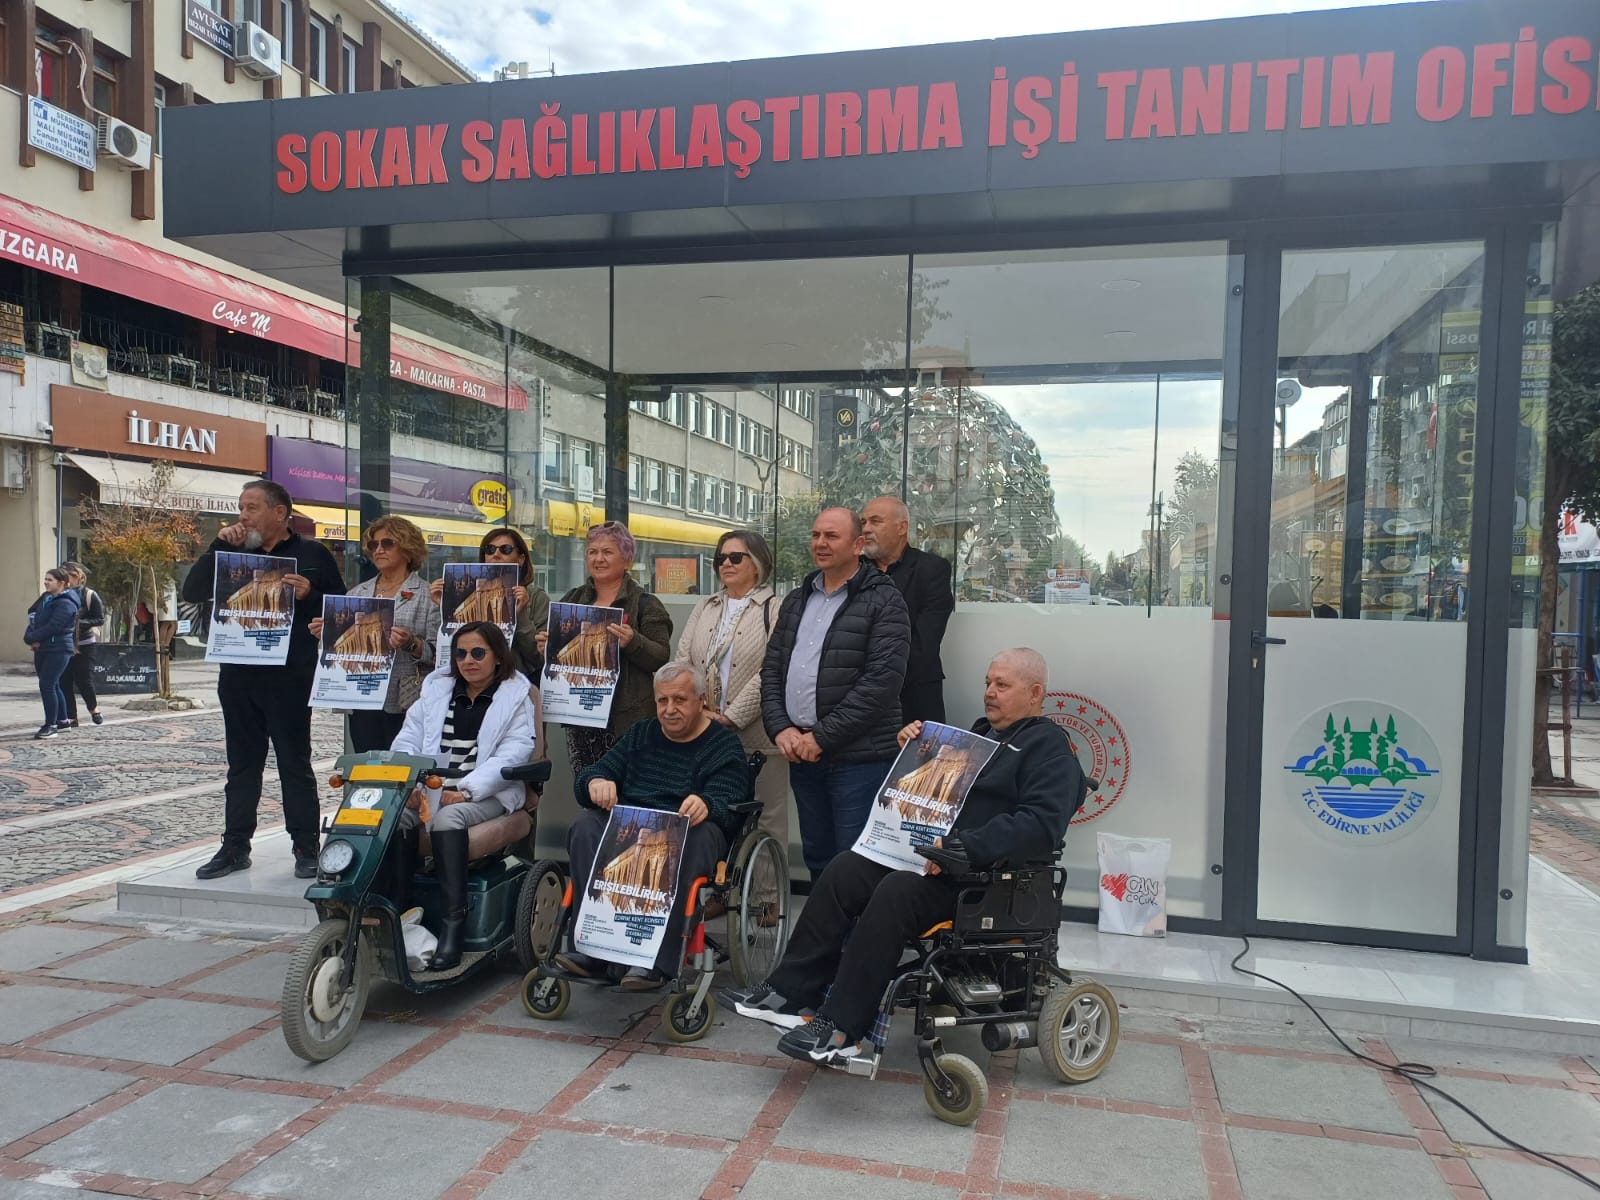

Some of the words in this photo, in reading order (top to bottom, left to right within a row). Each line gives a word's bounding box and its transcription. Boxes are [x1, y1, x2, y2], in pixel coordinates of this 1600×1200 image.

[191, 7, 230, 38] AVUKAT
[56, 111, 84, 129] SERBEST
[276, 123, 449, 194] SOKAK
[461, 82, 963, 182] SAĞLIKLAŞTIRMA
[987, 62, 1077, 159] İŞİ
[1097, 51, 1395, 140] TANITIM
[1415, 26, 1600, 121] OFİS
[0, 229, 79, 274] IZGARA
[212, 301, 248, 327] Cafe
[251, 311, 271, 332] M
[410, 366, 455, 391] MAKARNA
[463, 380, 486, 399] PASTA
[126, 409, 218, 455] İLHAN
[171, 495, 201, 509] BUTİK
[206, 497, 237, 511] İLHAN
[478, 488, 508, 506] gratis
[323, 526, 346, 539] gratis
[218, 609, 287, 620] ERİŞİLEBİLİRLİK
[1080, 724, 1090, 735] VE
[884, 788, 955, 815] ERİŞİLEBİLİRLİK
[1301, 788, 1320, 813] T.C.
[1318, 808, 1370, 835] EDİRNE
[1371, 791, 1425, 833] VALİLİĞİ
[593, 880, 668, 902] ERİŞİLEBİLİRLİK
